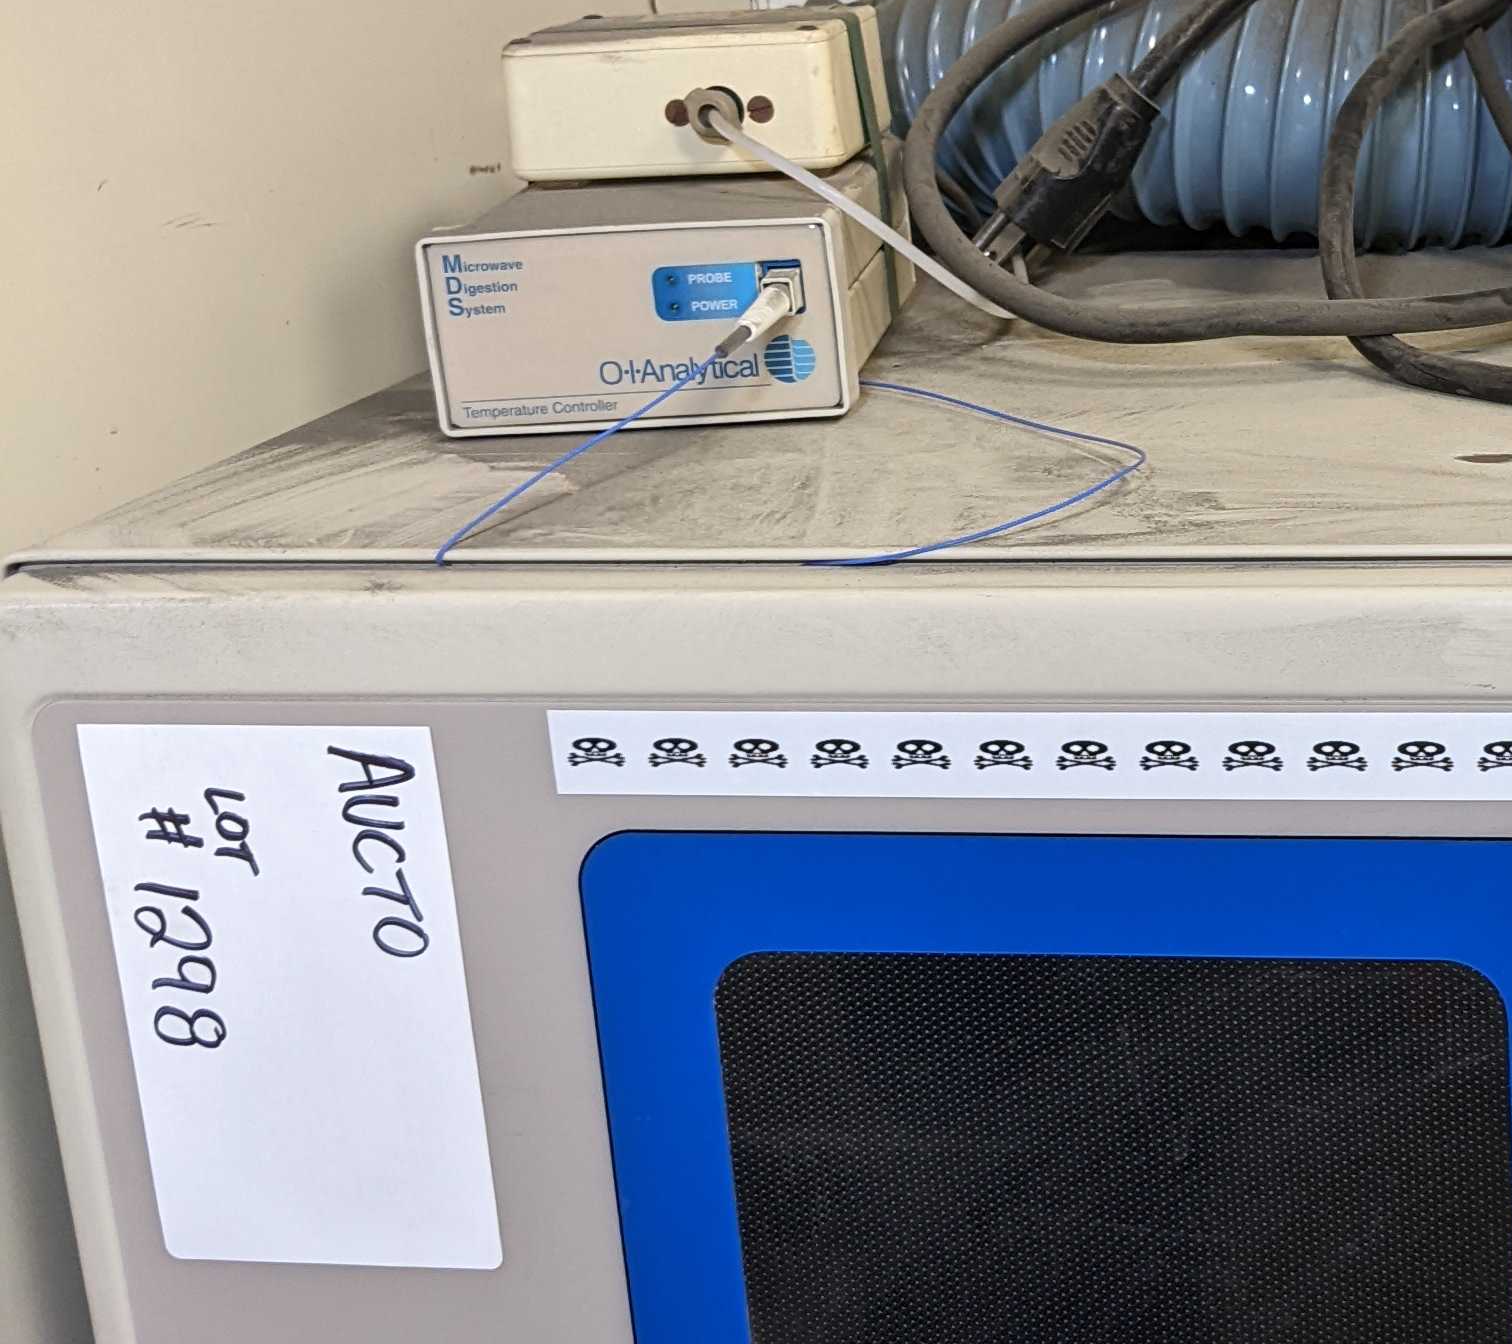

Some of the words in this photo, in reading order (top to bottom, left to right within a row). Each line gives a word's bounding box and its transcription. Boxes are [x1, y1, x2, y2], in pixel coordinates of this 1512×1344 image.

[441, 254, 524, 275] Microwave
[446, 277, 518, 296] Digestion
[687, 271, 733, 286] PROBE
[448, 298, 506, 317] System
[691, 298, 738, 313] POWER
[463, 404, 549, 421] Temperature
[552, 399, 618, 416] Controller
[133, 881, 228, 1049] 1298
